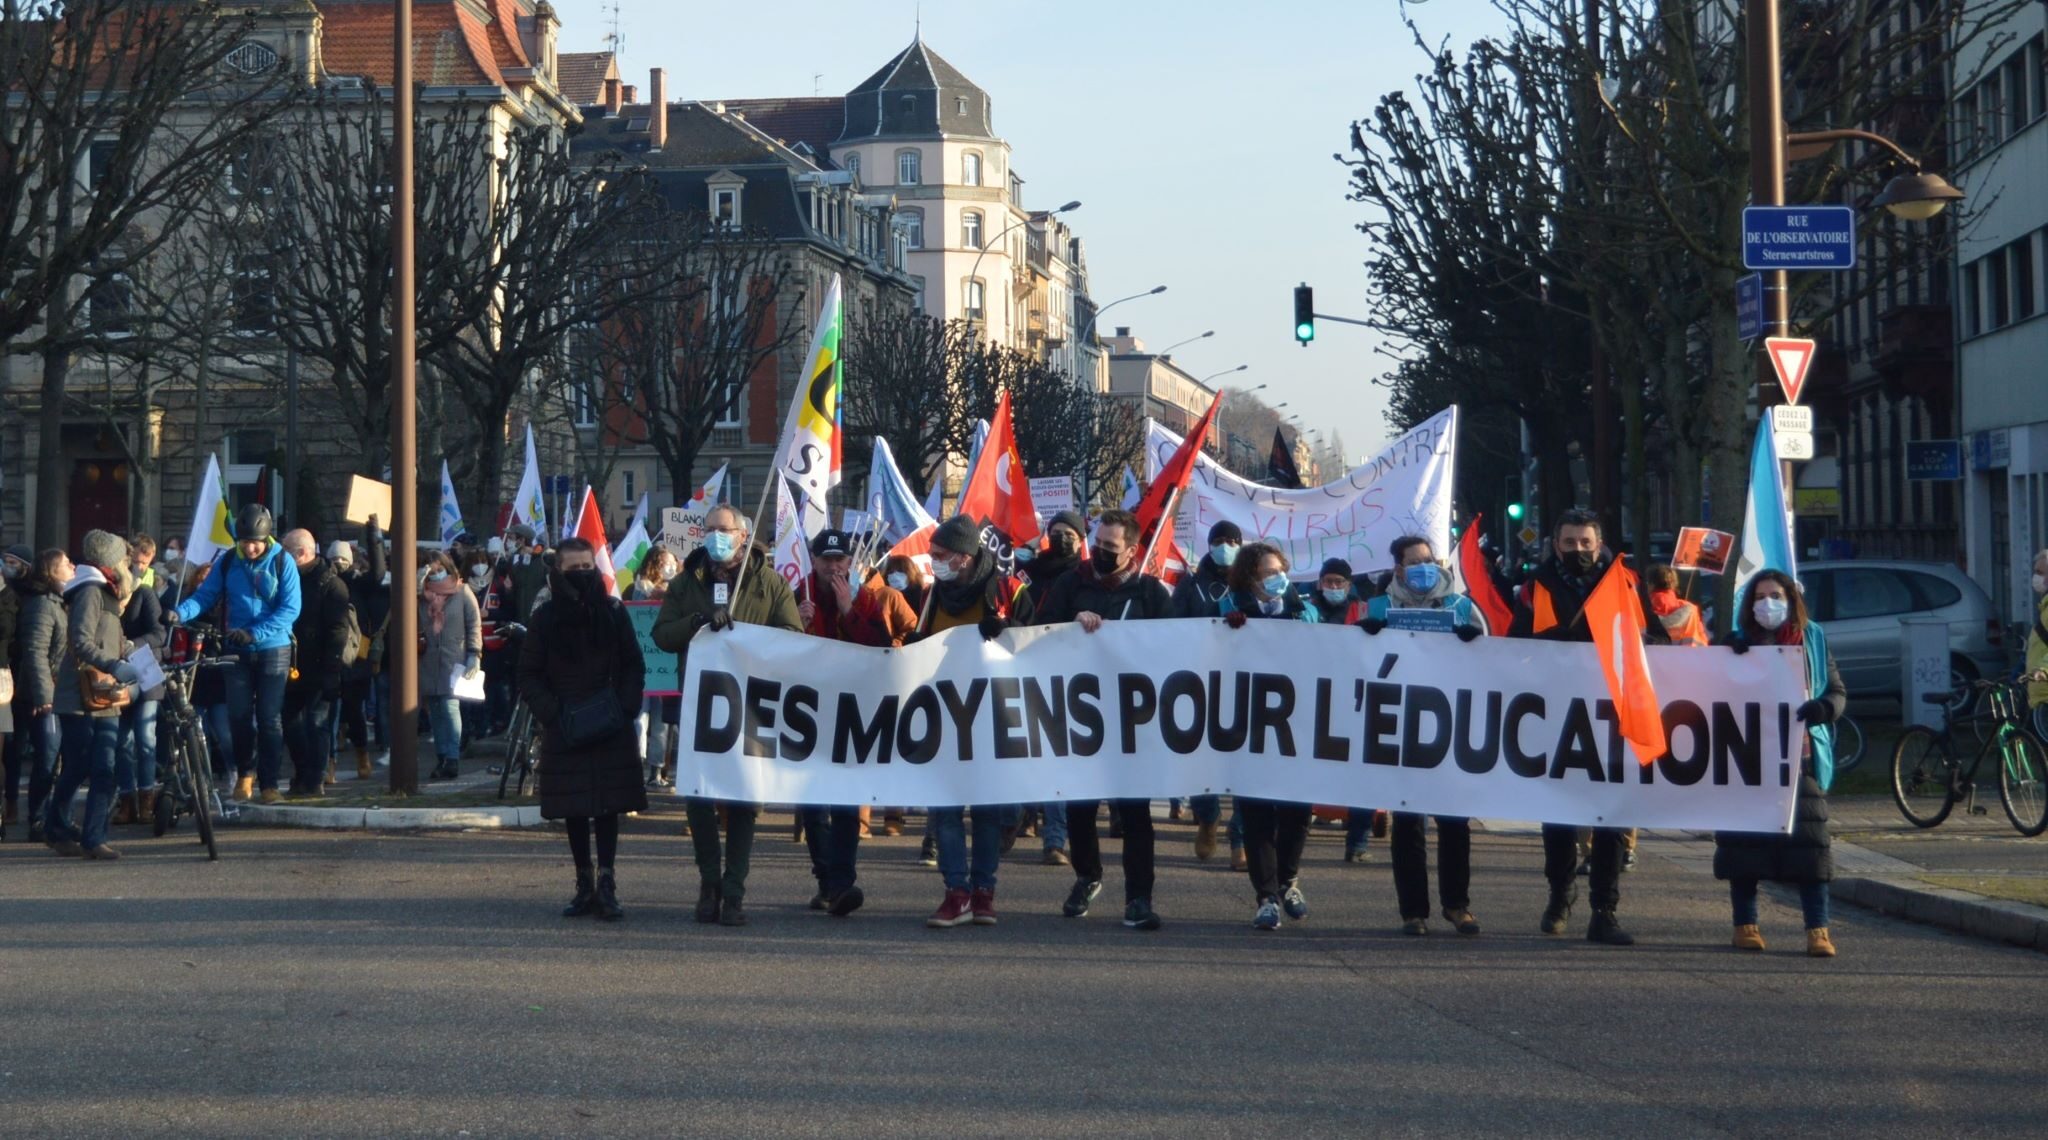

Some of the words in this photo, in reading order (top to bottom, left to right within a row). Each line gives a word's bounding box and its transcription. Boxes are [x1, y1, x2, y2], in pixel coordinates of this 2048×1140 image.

[1787, 215, 1808, 227] RUE
[1747, 232, 1761, 243] DE
[1763, 231, 1849, 243] L'OBSERVATOIRE
[1762, 248, 1834, 260] Sternewartstross
[1800, 411, 1807, 419] LE
[1779, 420, 1807, 429] PASSAGE
[1322, 413, 1450, 498] CONTRE
[1043, 489, 1069, 497] POSITIF
[693, 669, 819, 762] DES
[831, 672, 1105, 765] MOYENS
[1117, 669, 1297, 757] POUR
[1313, 652, 1761, 786] L'ÉDUCATON
[1779, 702, 1791, 787] !
